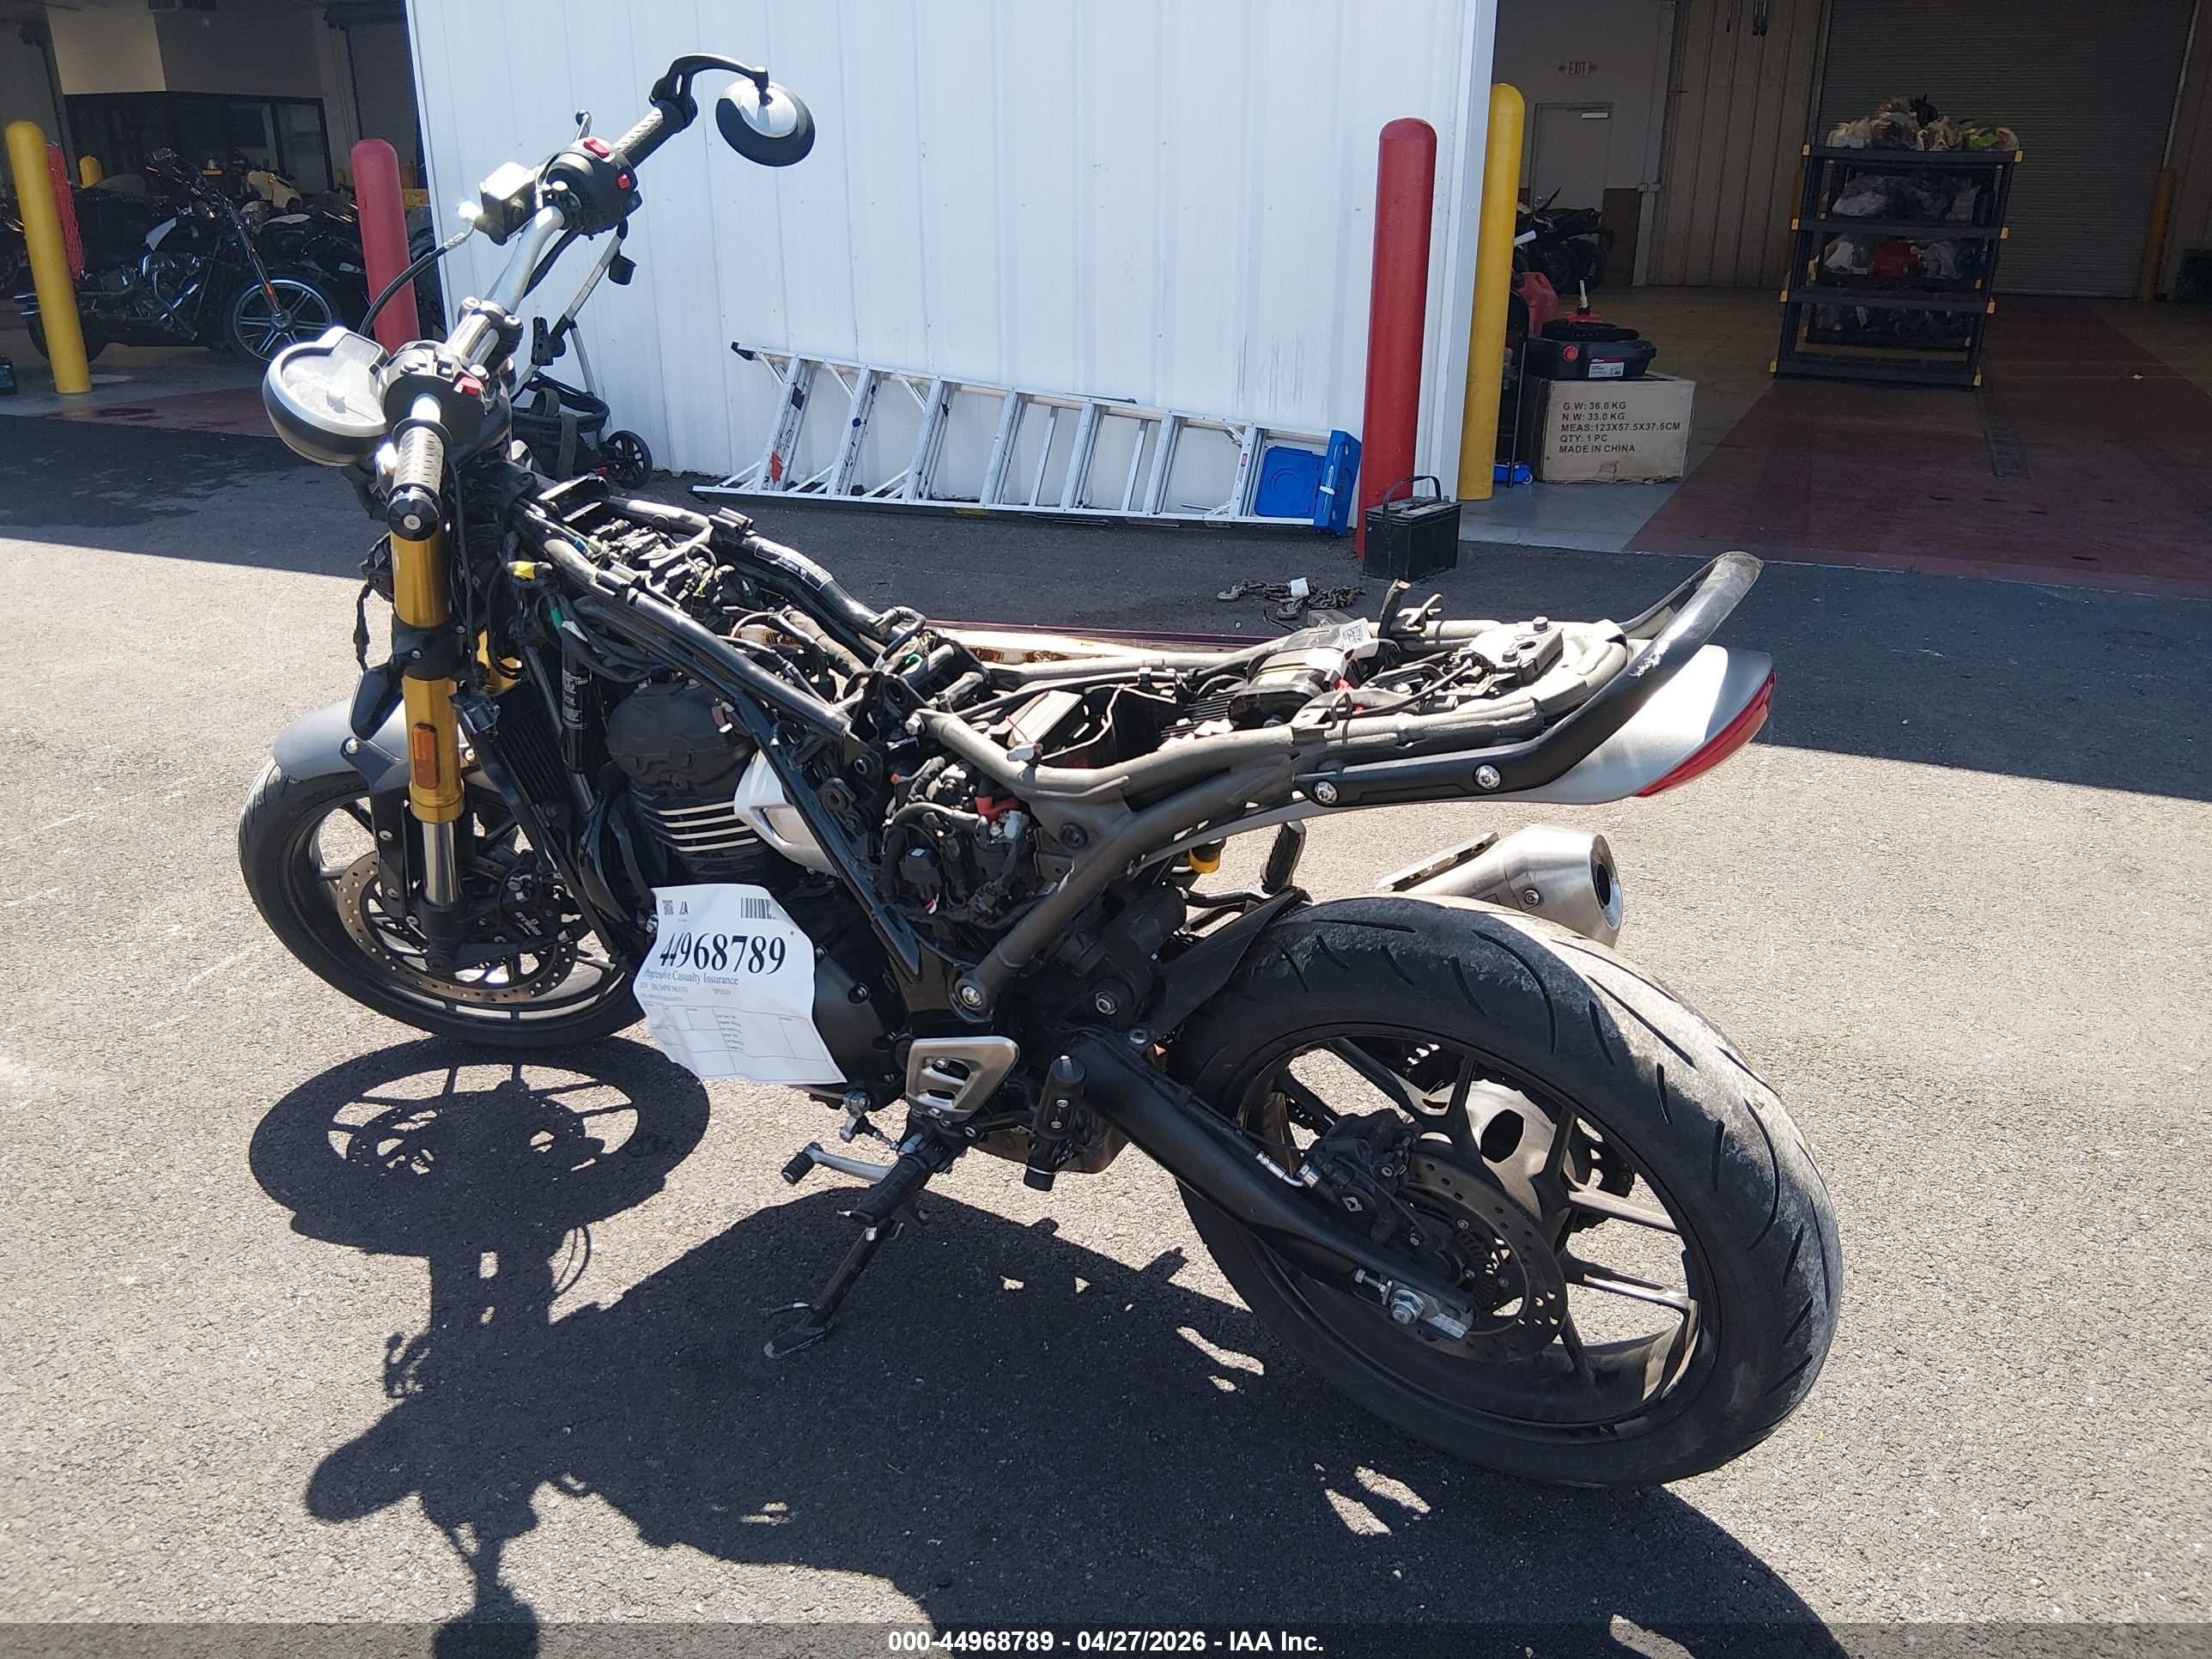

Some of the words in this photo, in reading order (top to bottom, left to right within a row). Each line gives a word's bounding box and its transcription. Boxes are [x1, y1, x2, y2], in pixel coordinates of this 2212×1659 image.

[1569, 61, 1587, 76] EXIT
[1563, 402, 1587, 410] G.W:
[1589, 402, 1609, 410] 36.0
[1612, 401, 1626, 410] KG
[1562, 413, 1585, 422] N.W:
[1610, 412, 1626, 421] KG
[1559, 434, 1583, 443] QTY:
[1559, 445, 1589, 453] MADE
[1591, 445, 1601, 453] IN
[1603, 444, 1636, 453] CHINA
[659, 932, 786, 975] 44968789
[672, 969, 702, 985] Casualty
[703, 972, 739, 986] Insurance
